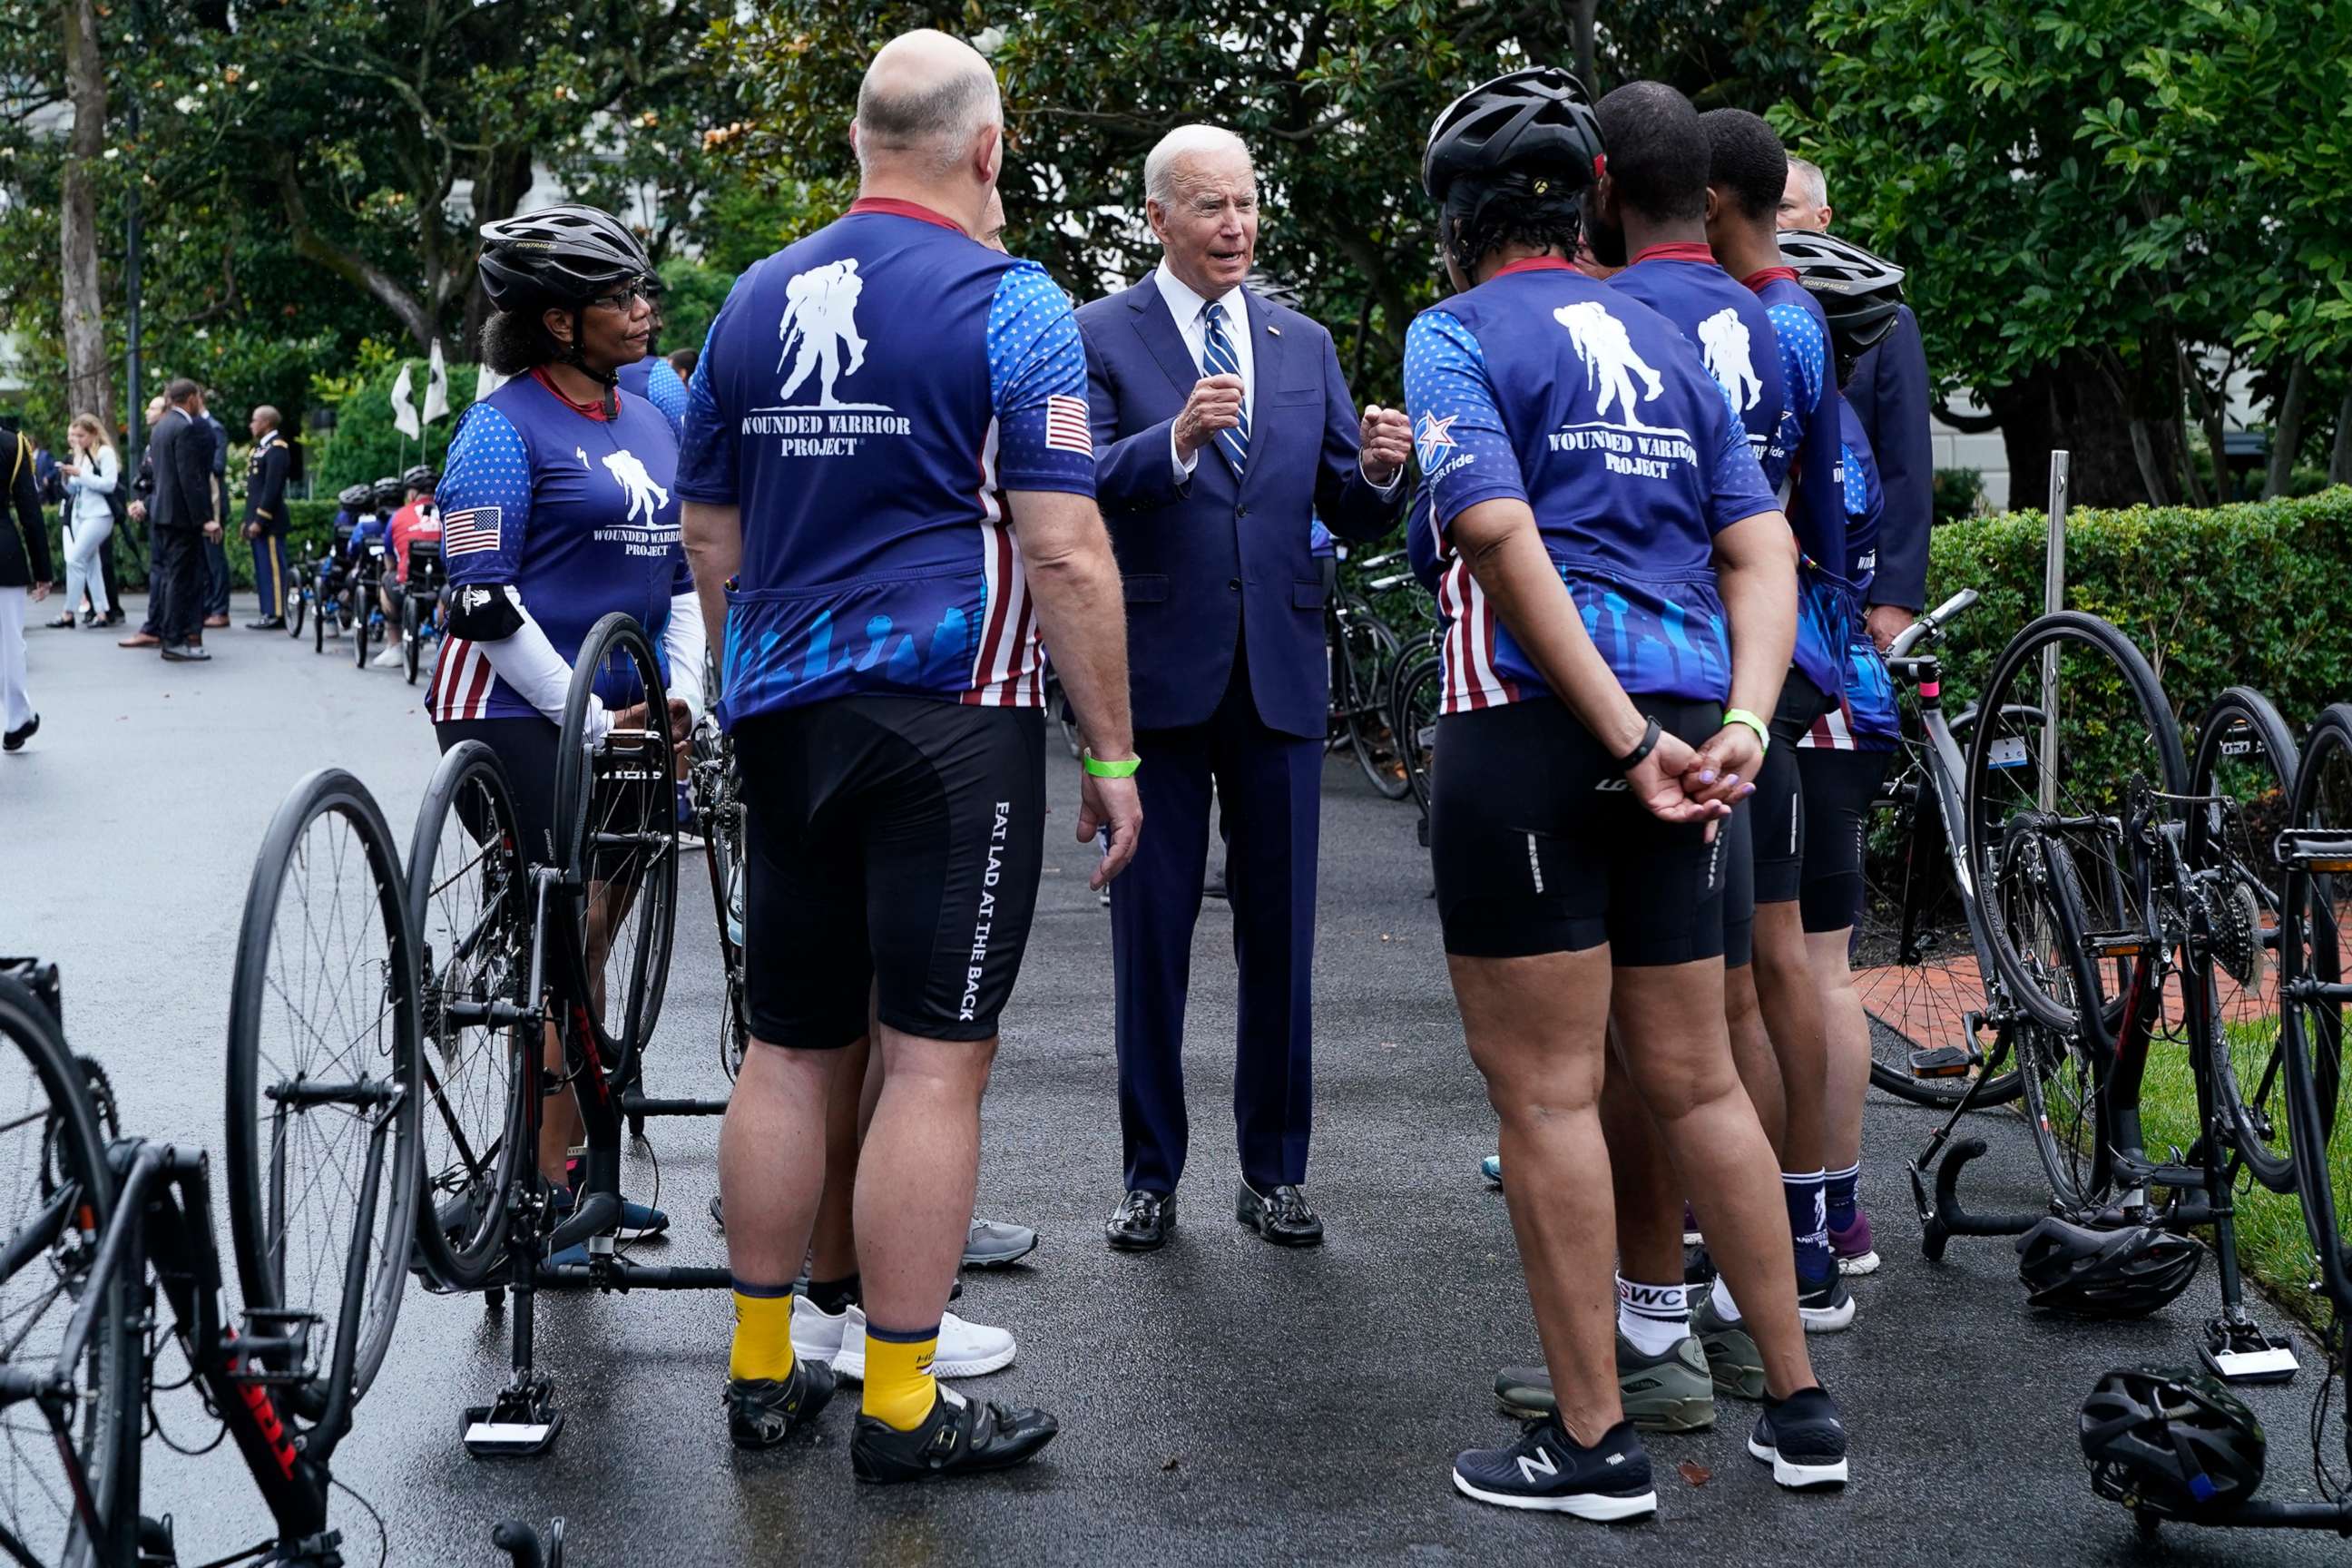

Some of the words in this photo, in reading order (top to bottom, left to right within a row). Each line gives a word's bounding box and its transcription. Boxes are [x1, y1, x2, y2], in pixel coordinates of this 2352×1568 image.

[828, 415, 911, 436] WARRIOR
[780, 437, 858, 456] PROJECT
[1603, 452, 1670, 480] PROJECT
[593, 529, 650, 543] WOUNDED
[624, 544, 669, 557] PROJECT
[991, 801, 1010, 841] FAT
[984, 845, 1004, 887] LAD
[978, 891, 995, 918] AT
[970, 922, 991, 963] THE
[959, 965, 983, 1022] BACK
